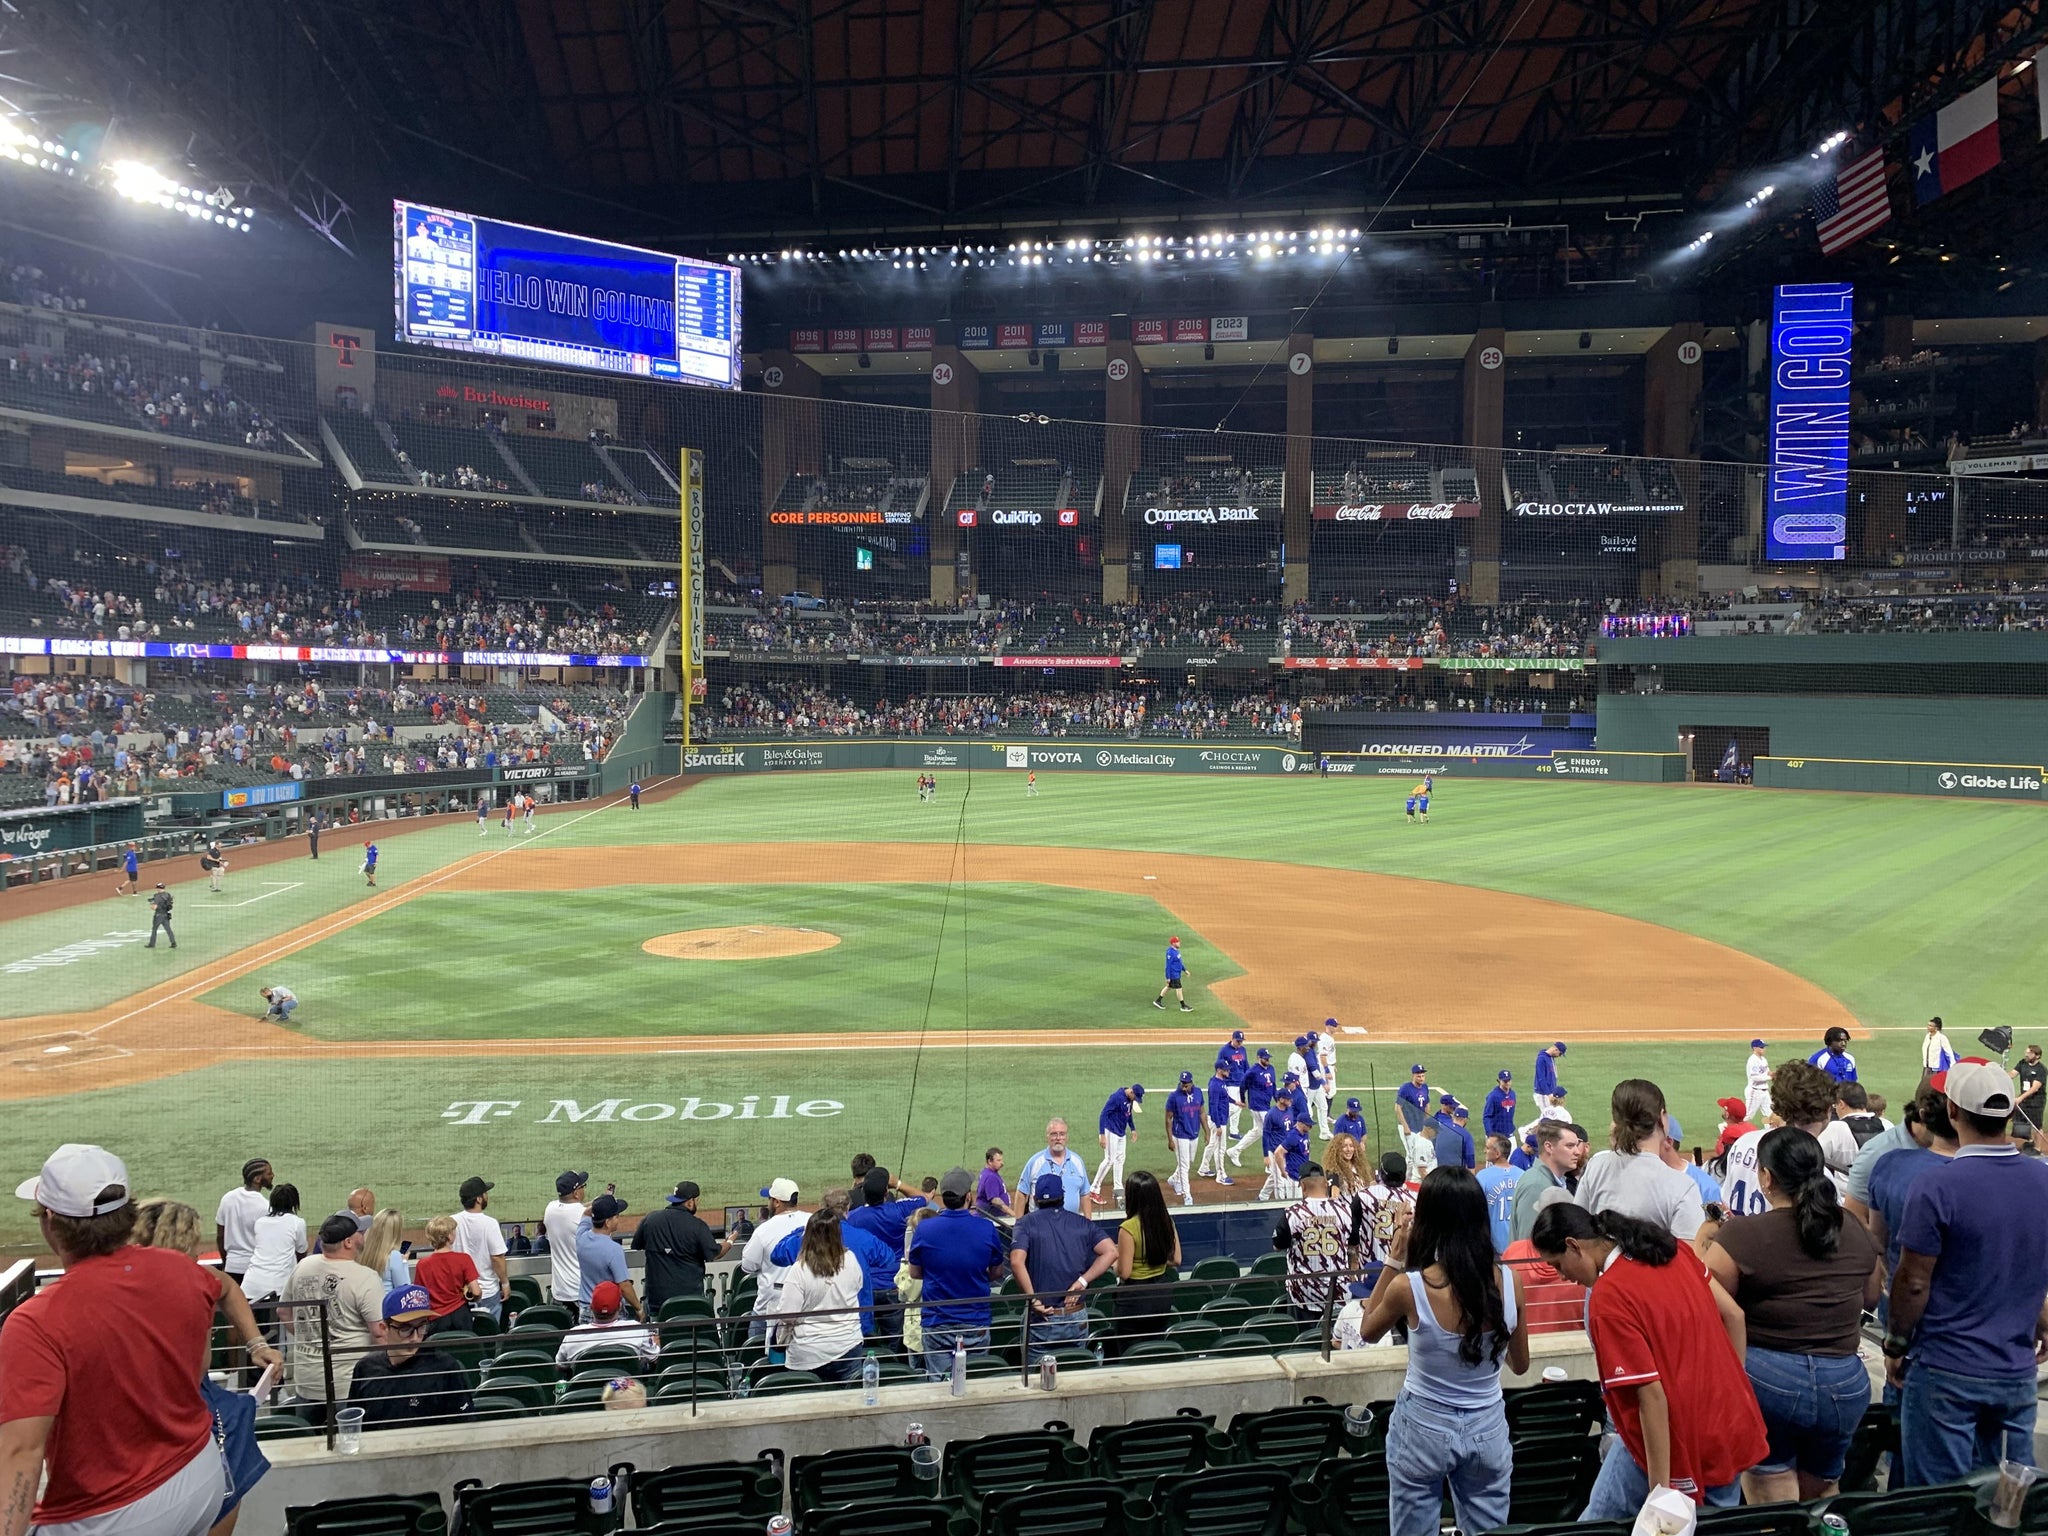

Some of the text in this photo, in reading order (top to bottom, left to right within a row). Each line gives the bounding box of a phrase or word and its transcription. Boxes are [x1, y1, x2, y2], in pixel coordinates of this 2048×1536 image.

[478, 266, 542, 311] HELLO
[545, 278, 588, 318] WIN
[592, 287, 673, 332] COLUMN
[1042, 324, 1062, 334] 2011
[1080, 323, 1104, 334] 2012
[1138, 321, 1162, 332] 2015
[1178, 320, 1202, 330] 2016
[1216, 318, 1243, 329] 2023
[796, 331, 818, 341] 1996
[834, 330, 856, 340] 1998
[870, 329, 892, 339] 1999
[908, 328, 930, 338] 2010
[964, 326, 987, 337] 2010
[1004, 326, 1025, 336] 2011
[329, 331, 361, 368] T
[1682, 346, 1697, 360] 10
[1296, 357, 1305, 371] 7
[1483, 352, 1500, 365] 29
[935, 368, 950, 380] 34
[1110, 364, 1126, 376] 26
[766, 371, 781, 384] 42
[1774, 402, 1849, 502] WIN
[1968, 460, 2018, 469] VOLLEMANS
[1218, 506, 1259, 521] Bank
[1336, 504, 1384, 521] Coca-Cola
[1406, 502, 1457, 520] Coca-Cola
[1525, 502, 1612, 515] CHOCTAW
[770, 512, 884, 524] CORE PERSONNEL
[959, 512, 974, 524] QT
[992, 510, 1042, 526] QuikTrip
[1060, 512, 1075, 524] QT
[1906, 550, 2006, 562] PRIORITY GOLD
[372, 568, 418, 582] FOUNDATION
[692, 491, 702, 662] ROOT 4 CHIKIN
[463, 651, 538, 665] RANGERS WIN
[1455, 658, 1580, 670] LUXOR STAFFING
[1206, 752, 1261, 761] CHOCTAW
[1360, 744, 1508, 757] LOCKHEED MARTIN
[684, 752, 745, 768] SEATGEEK
[1031, 752, 1082, 764] TOYOTA
[1114, 754, 1176, 768] Medical City
[1787, 760, 1804, 768] 407
[504, 767, 548, 780] VICTORY
[1571, 766, 1609, 774] TRANSFER
[1960, 774, 2040, 790] Globe Life
[16, 823, 51, 849] Kroger
[534, 1095, 844, 1124] Mobile
[1374, 1210, 1392, 1240] 2
[1303, 1226, 1339, 1256] 26
